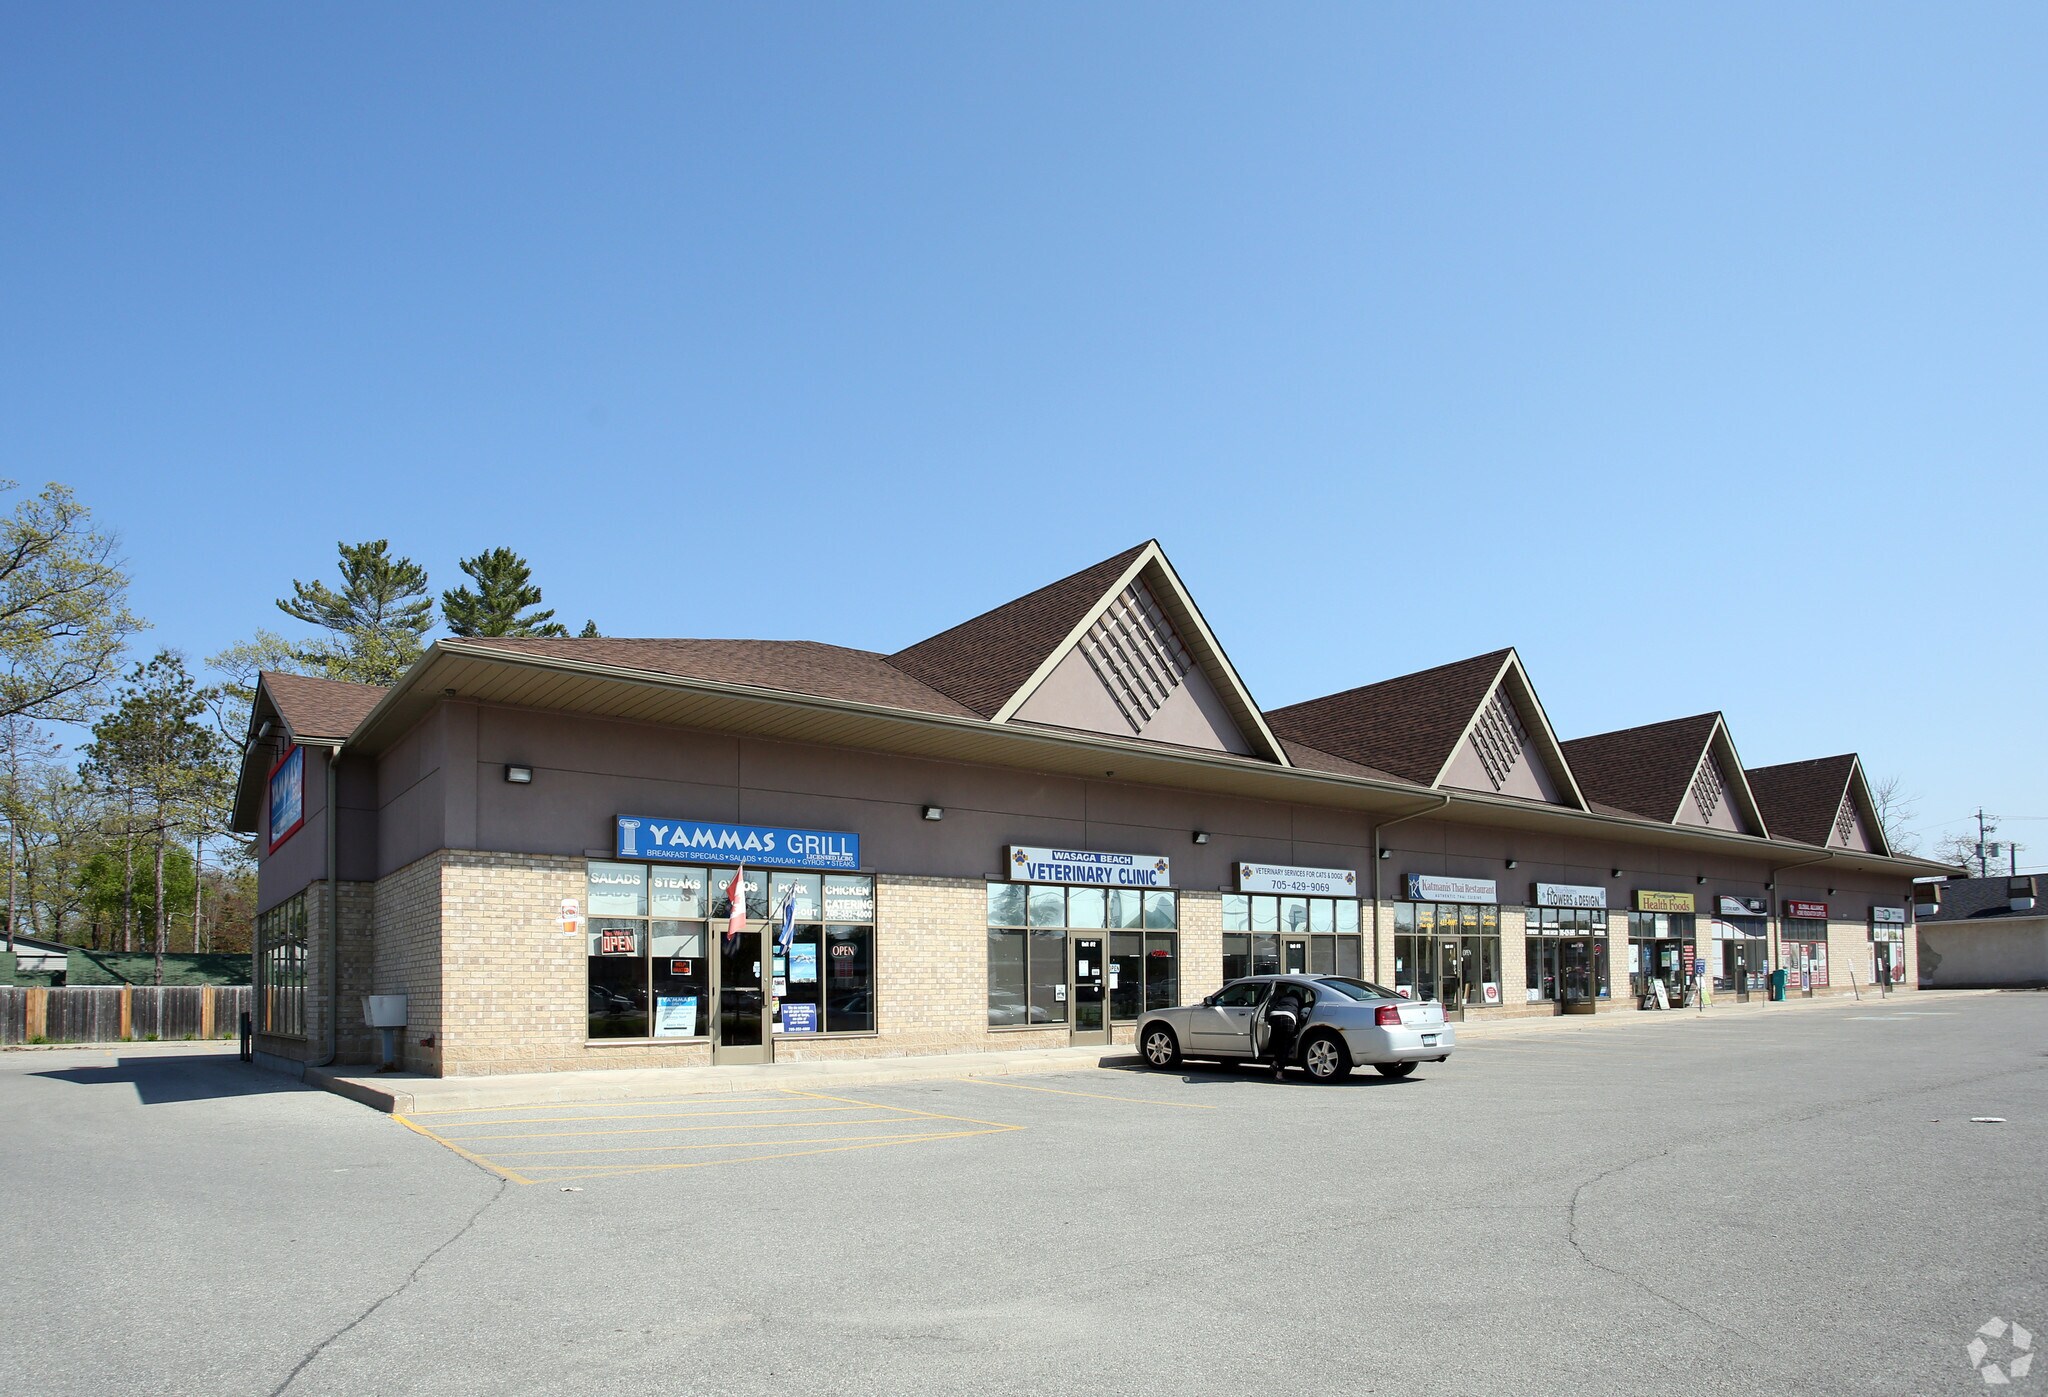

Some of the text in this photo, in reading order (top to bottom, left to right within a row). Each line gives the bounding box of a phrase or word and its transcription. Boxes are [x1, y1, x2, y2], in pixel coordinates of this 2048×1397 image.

[649, 824, 853, 857] YAMMAS GRILL
[646, 849, 855, 868] BREAKFAST SPECIALS SALADS SOUVLAKI GYROS STEAKS
[1053, 851, 1131, 864] WASAGA BEACH
[590, 872, 641, 885] SALADS
[1026, 862, 1157, 886] VETERINARY CLINIC
[1255, 867, 1283, 876] VETERINARY
[1284, 869, 1305, 877] SERVICES
[1306, 870, 1315, 878] FOR
[1315, 871, 1327, 879] CATS
[1331, 872, 1343, 880] DOGS
[654, 877, 701, 890] STEAKS
[718, 880, 759, 892] GOS
[778, 882, 809, 895] PORK
[1271, 879, 1330, 892] 705-429-9069
[1451, 882, 1464, 892] Thai
[1465, 884, 1494, 894] Restaurant
[825, 886, 869, 896] CHICKEN
[825, 899, 873, 910] CATERING
[1578, 894, 1600, 906] DESIGN
[1643, 897, 1689, 911] Health Foods
[603, 936, 634, 952] OPEN
[832, 946, 855, 956] OPEN
